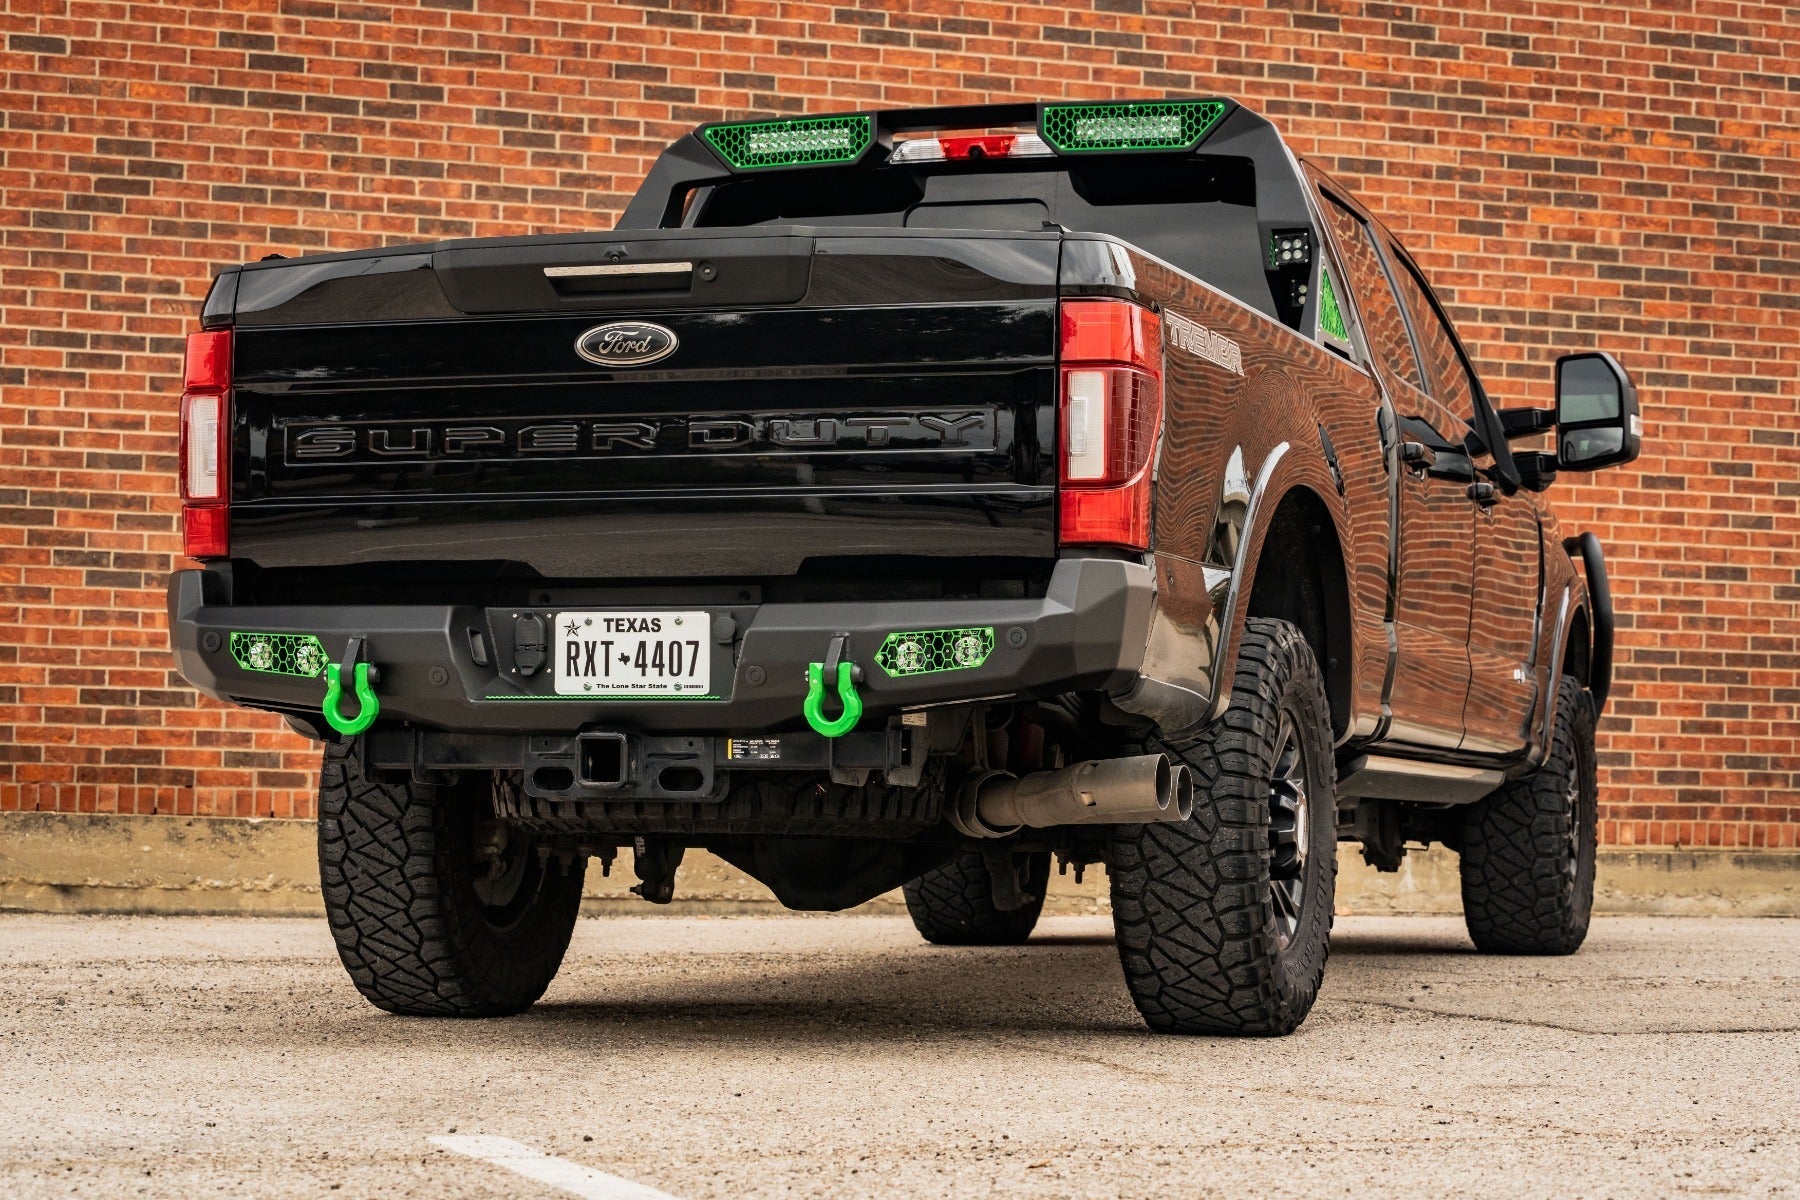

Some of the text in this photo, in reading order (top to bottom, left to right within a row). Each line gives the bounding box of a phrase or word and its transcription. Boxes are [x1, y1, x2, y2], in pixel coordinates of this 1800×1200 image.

[598, 330, 653, 354] Ford
[295, 413, 989, 458] SUPER DUTY
[603, 617, 662, 633] TEXAS
[566, 640, 700, 677] RXT 4407
